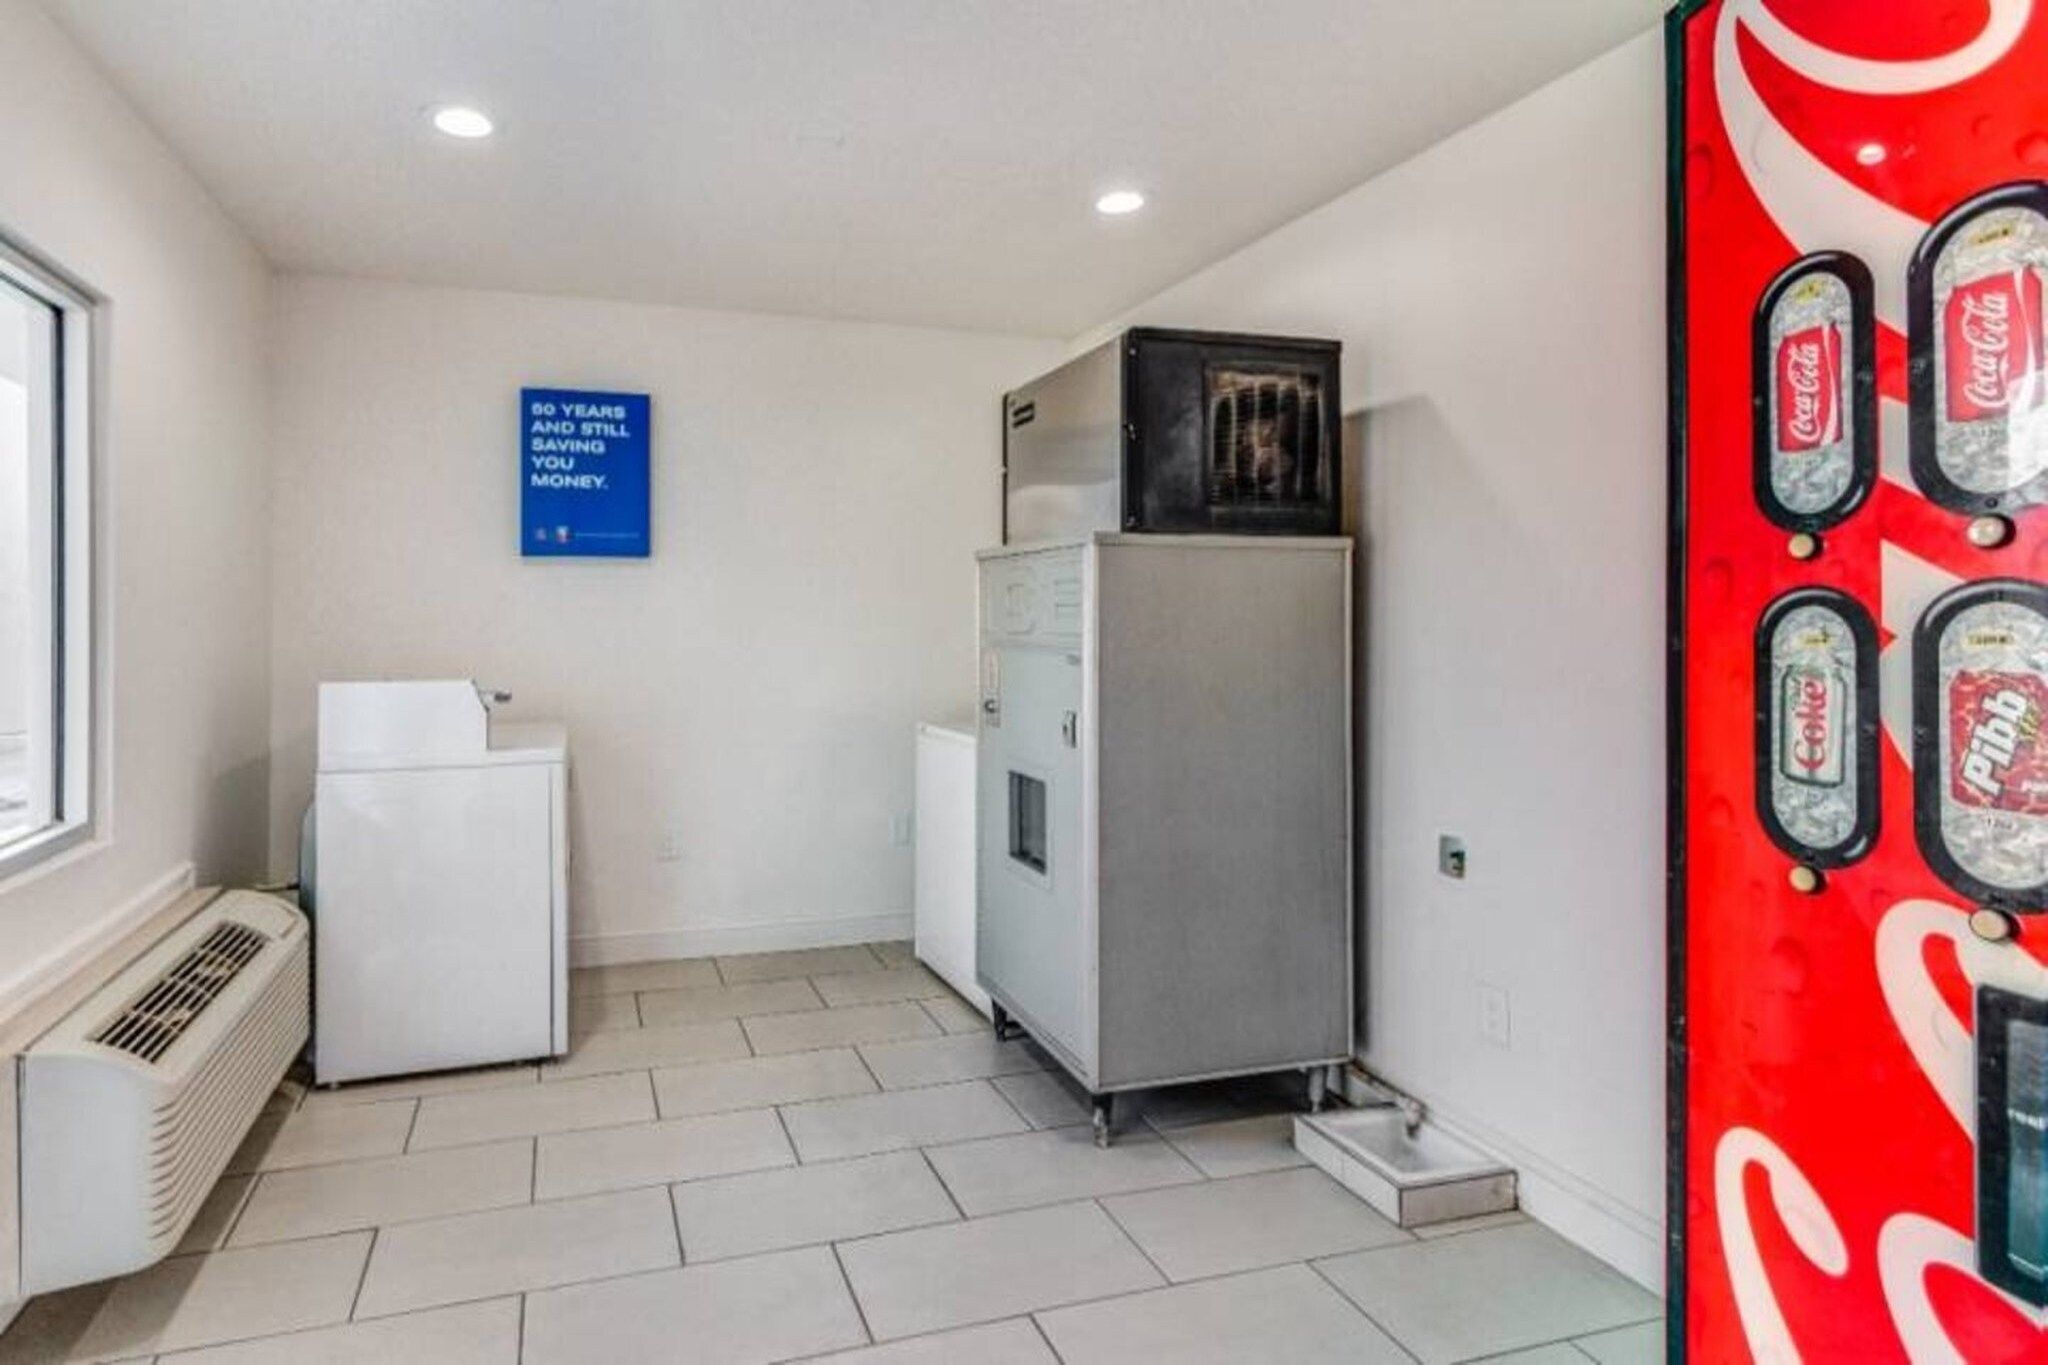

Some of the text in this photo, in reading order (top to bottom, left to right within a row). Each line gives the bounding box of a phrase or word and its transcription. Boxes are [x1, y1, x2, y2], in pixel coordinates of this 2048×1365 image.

[562, 404, 627, 419] YEARS
[531, 420, 631, 437] AND STILL
[531, 437, 606, 454] SAVING
[531, 455, 575, 471] YOU
[530, 474, 609, 490] MONEY.
[1793, 678, 1827, 771] Coke
[1961, 688, 2031, 798] Pibb
